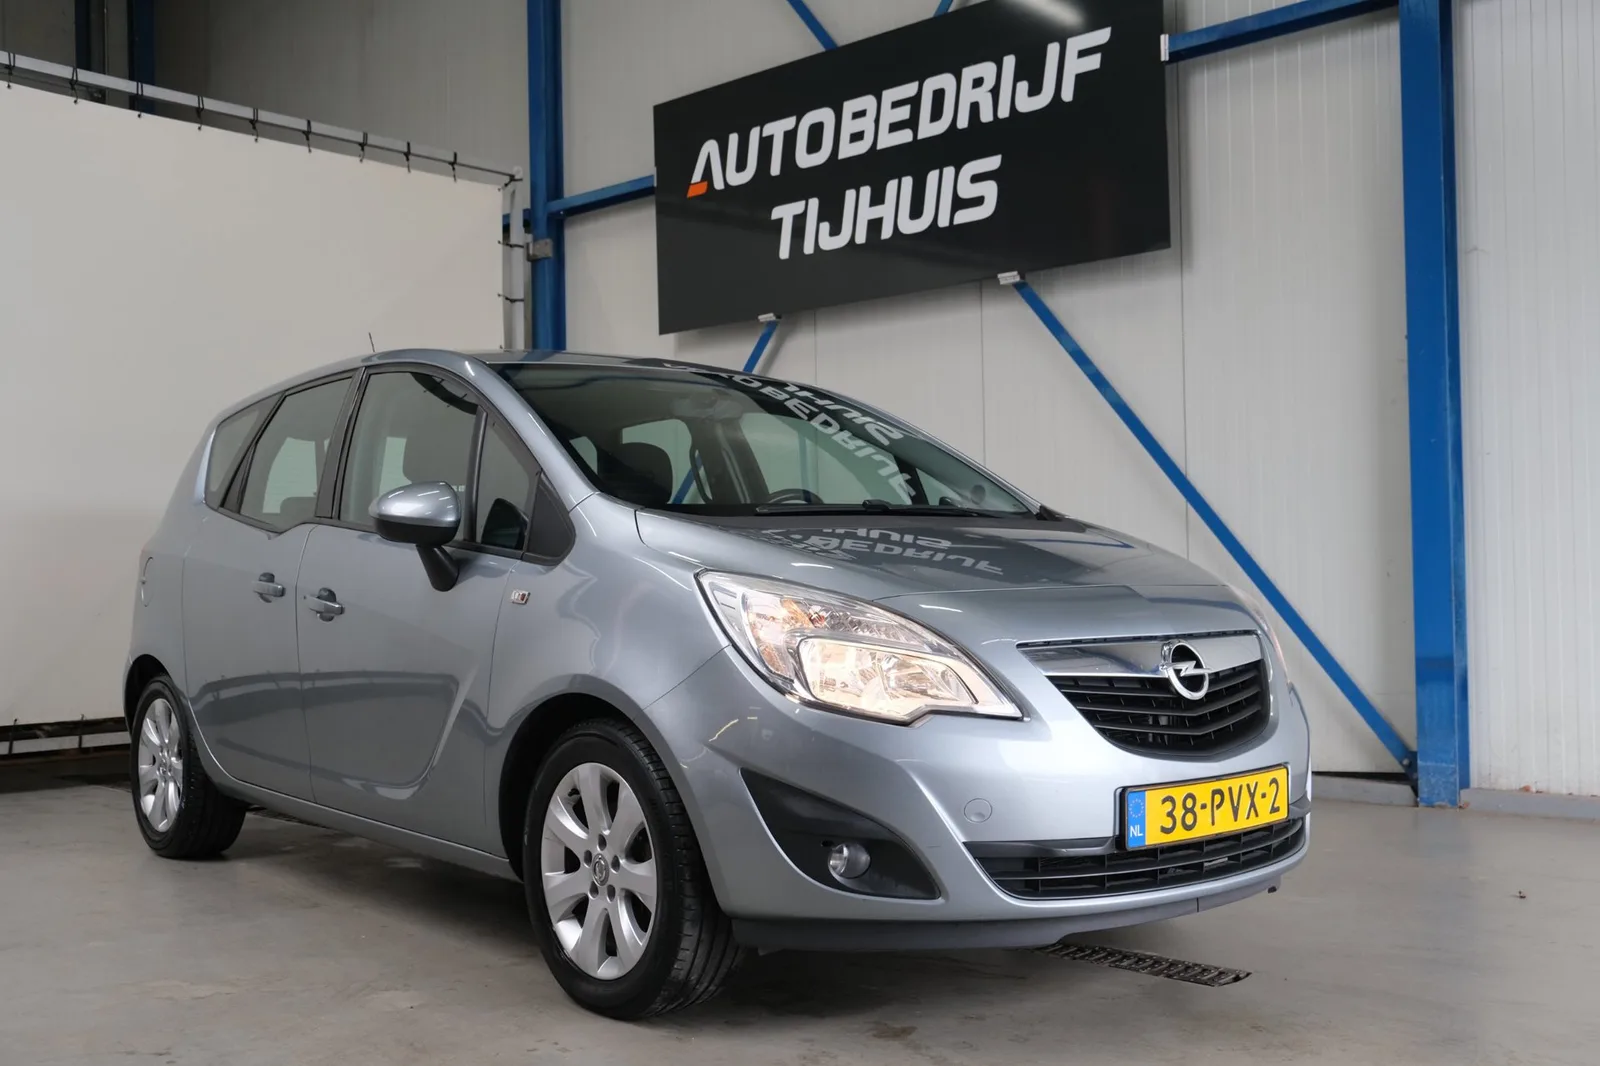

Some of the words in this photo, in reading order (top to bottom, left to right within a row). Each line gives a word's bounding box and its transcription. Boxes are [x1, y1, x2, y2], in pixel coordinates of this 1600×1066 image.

[686, 26, 1111, 198] AUTOBEDRIJF
[771, 155, 1002, 260] TIJHUIS
[1129, 825, 1144, 838] NL
[1160, 777, 1281, 834] 38-PVX-2
